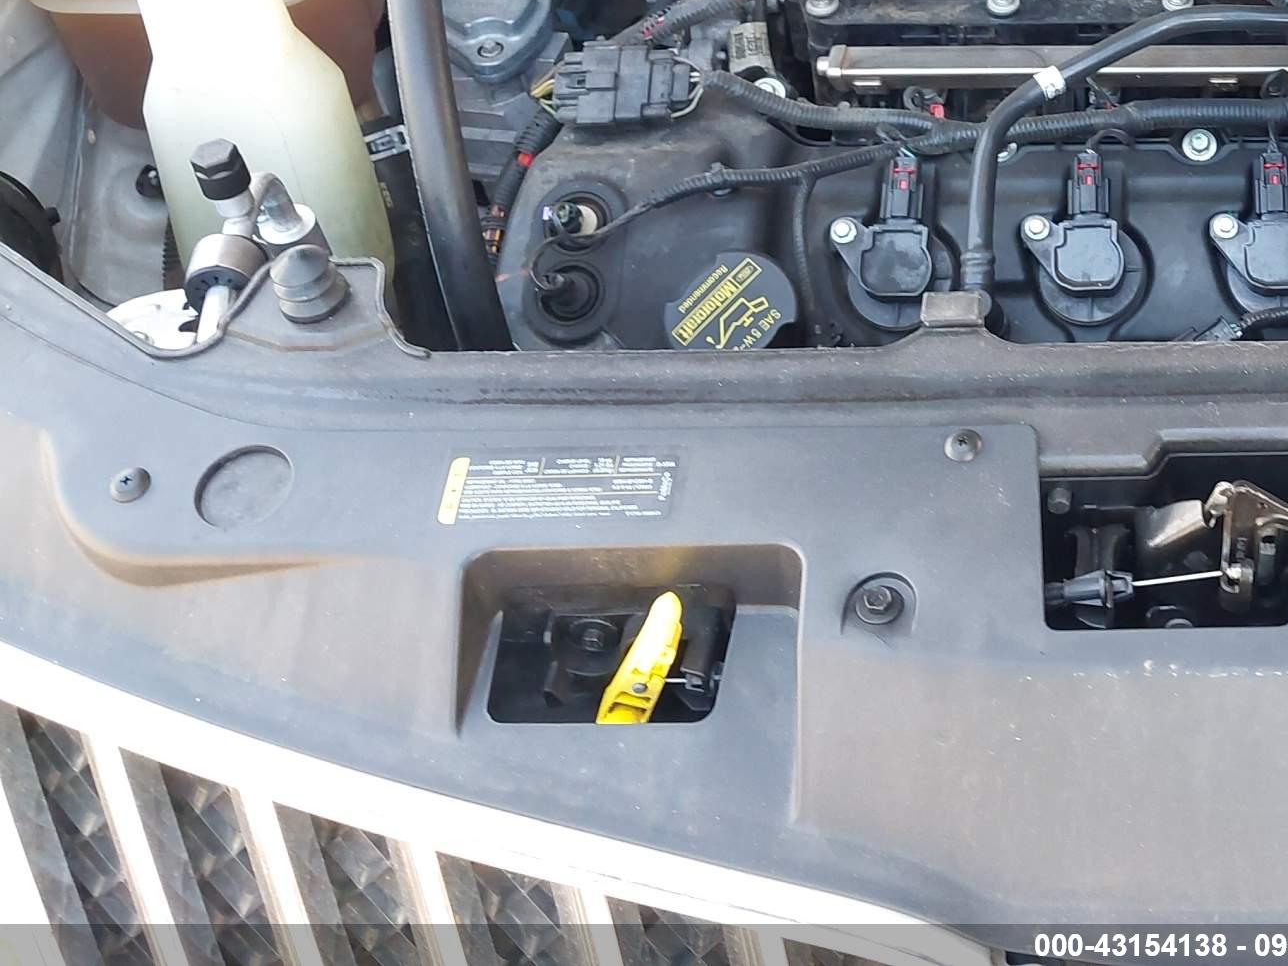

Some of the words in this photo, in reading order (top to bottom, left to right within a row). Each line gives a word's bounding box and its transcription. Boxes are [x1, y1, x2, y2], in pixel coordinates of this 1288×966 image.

[679, 264, 729, 314] Recommended
[681, 279, 739, 339] Motorcraft
[758, 308, 781, 331] SAE
